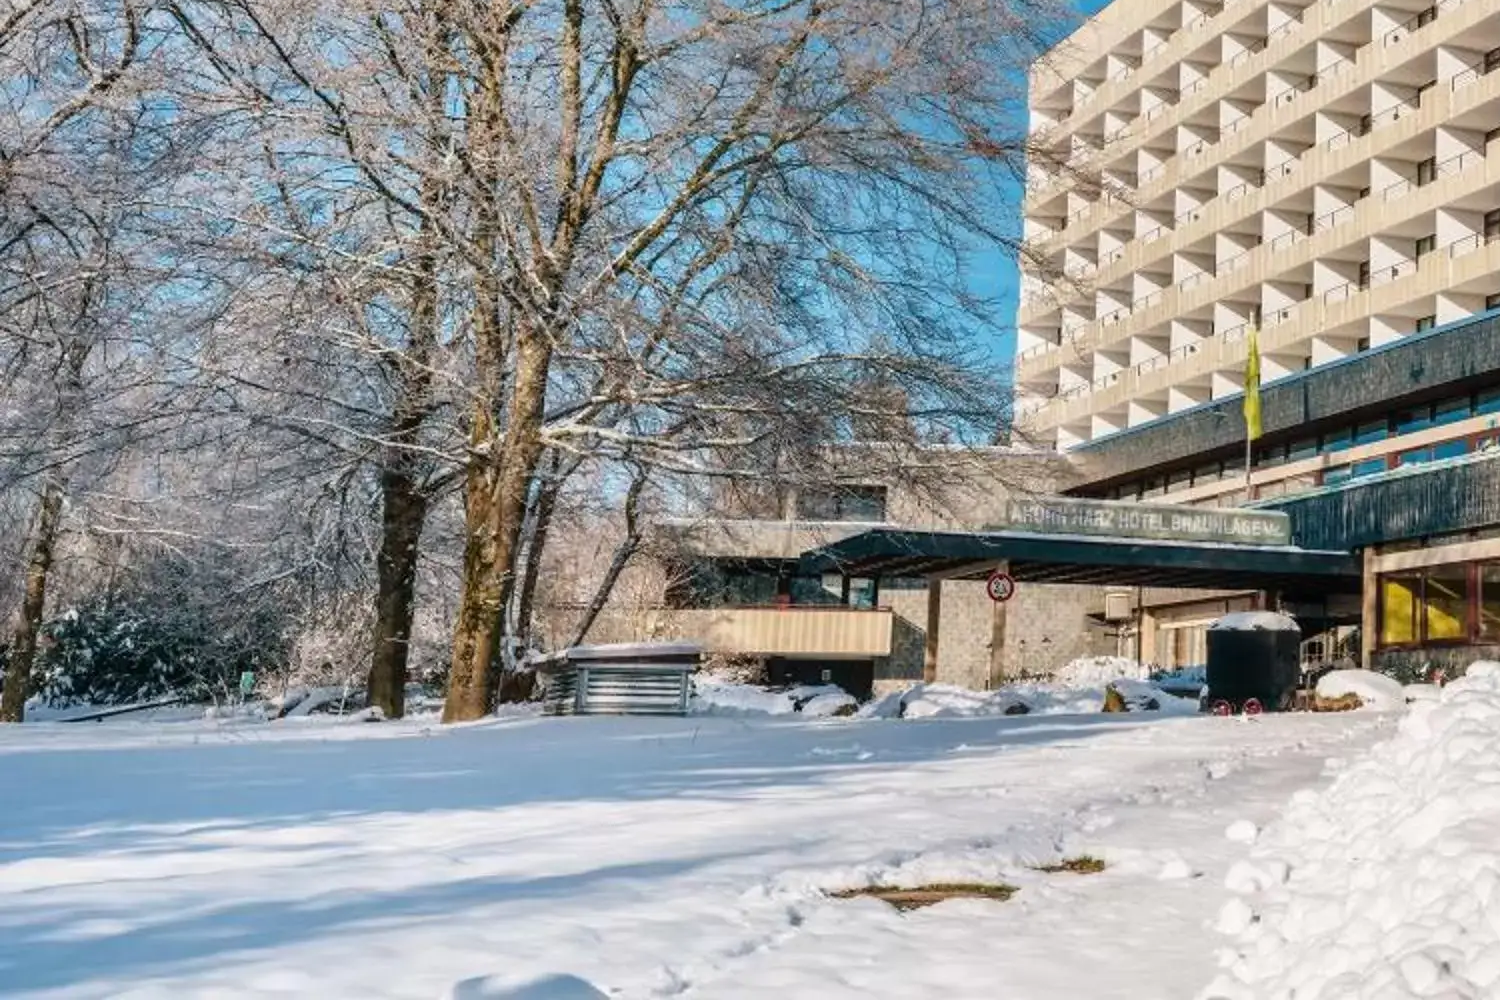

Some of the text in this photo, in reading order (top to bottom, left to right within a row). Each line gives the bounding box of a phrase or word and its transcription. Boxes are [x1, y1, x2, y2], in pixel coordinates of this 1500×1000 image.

[1072, 507, 1114, 527] HARZ
[1119, 511, 1169, 531] HOTEL
[1172, 514, 1262, 537] BRAUNLAGE
